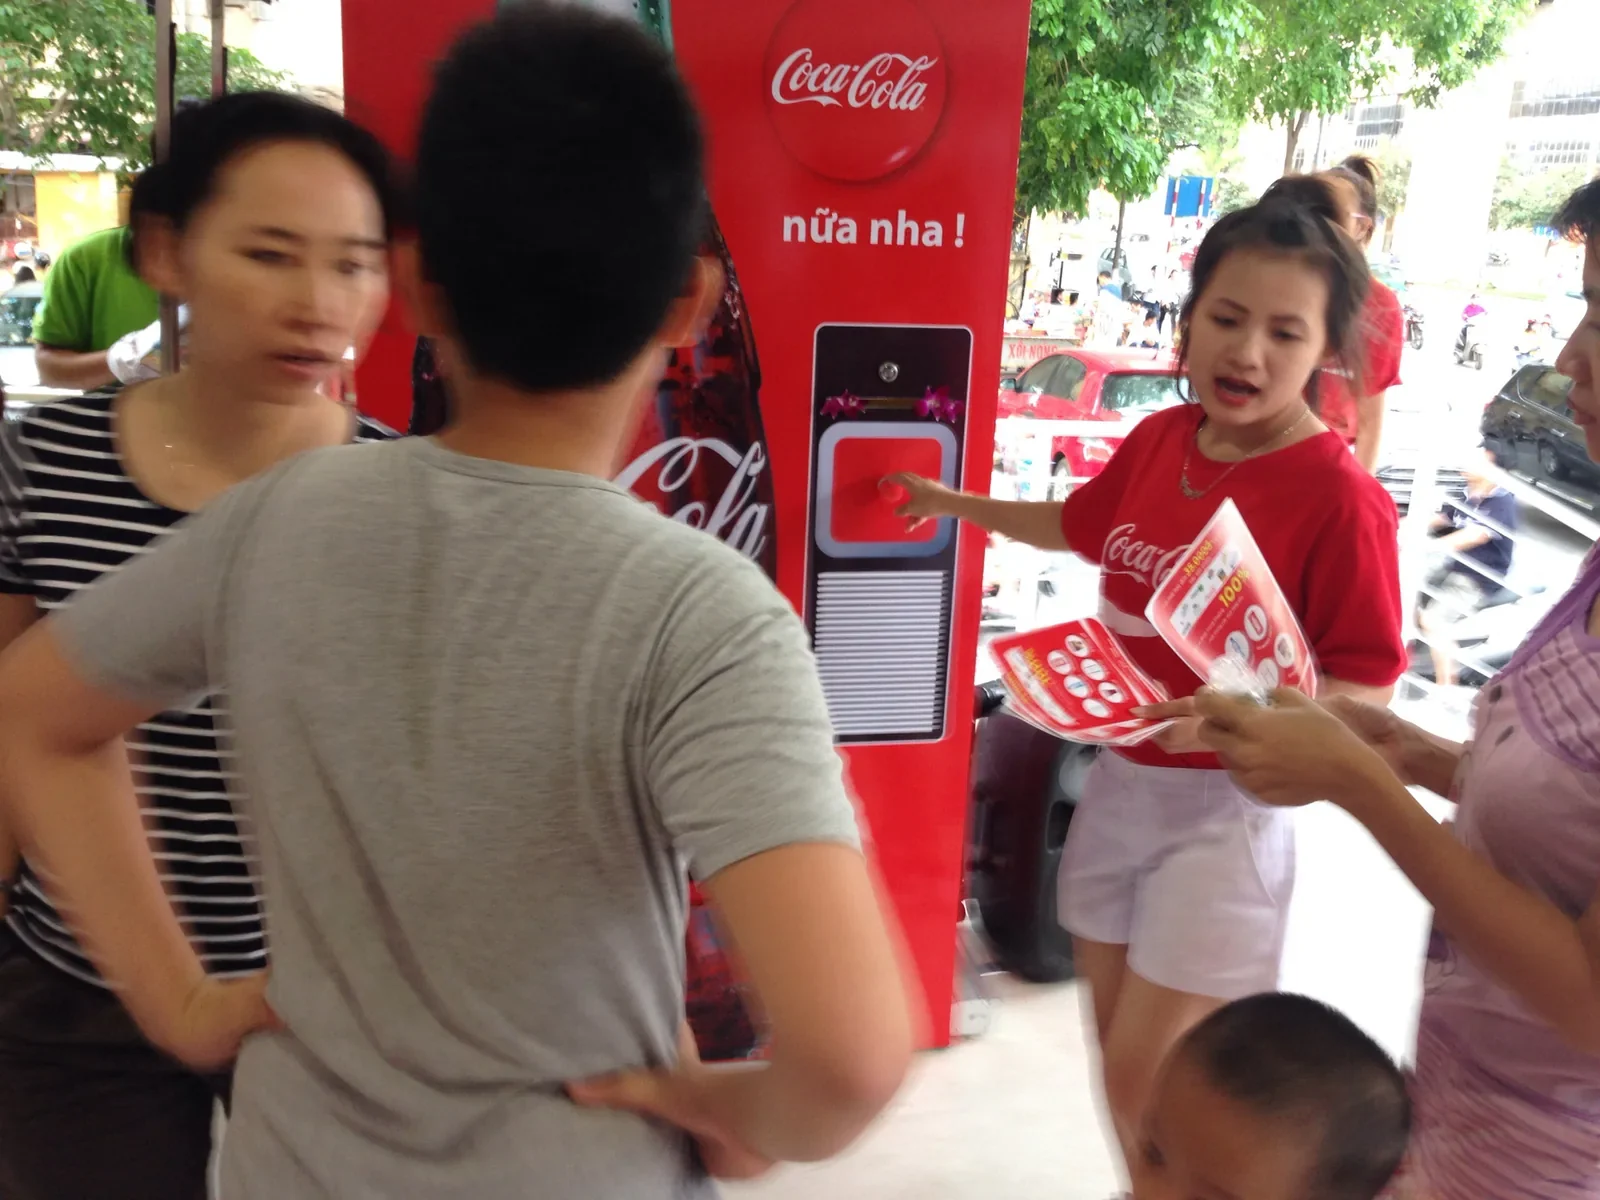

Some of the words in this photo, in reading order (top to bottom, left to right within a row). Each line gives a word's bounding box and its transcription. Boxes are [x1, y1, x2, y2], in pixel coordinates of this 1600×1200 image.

[771, 48, 938, 111] Coca-Cola
[783, 208, 857, 244] nữa
[870, 209, 943, 247] nha
[1218, 567, 1249, 608] 100%
